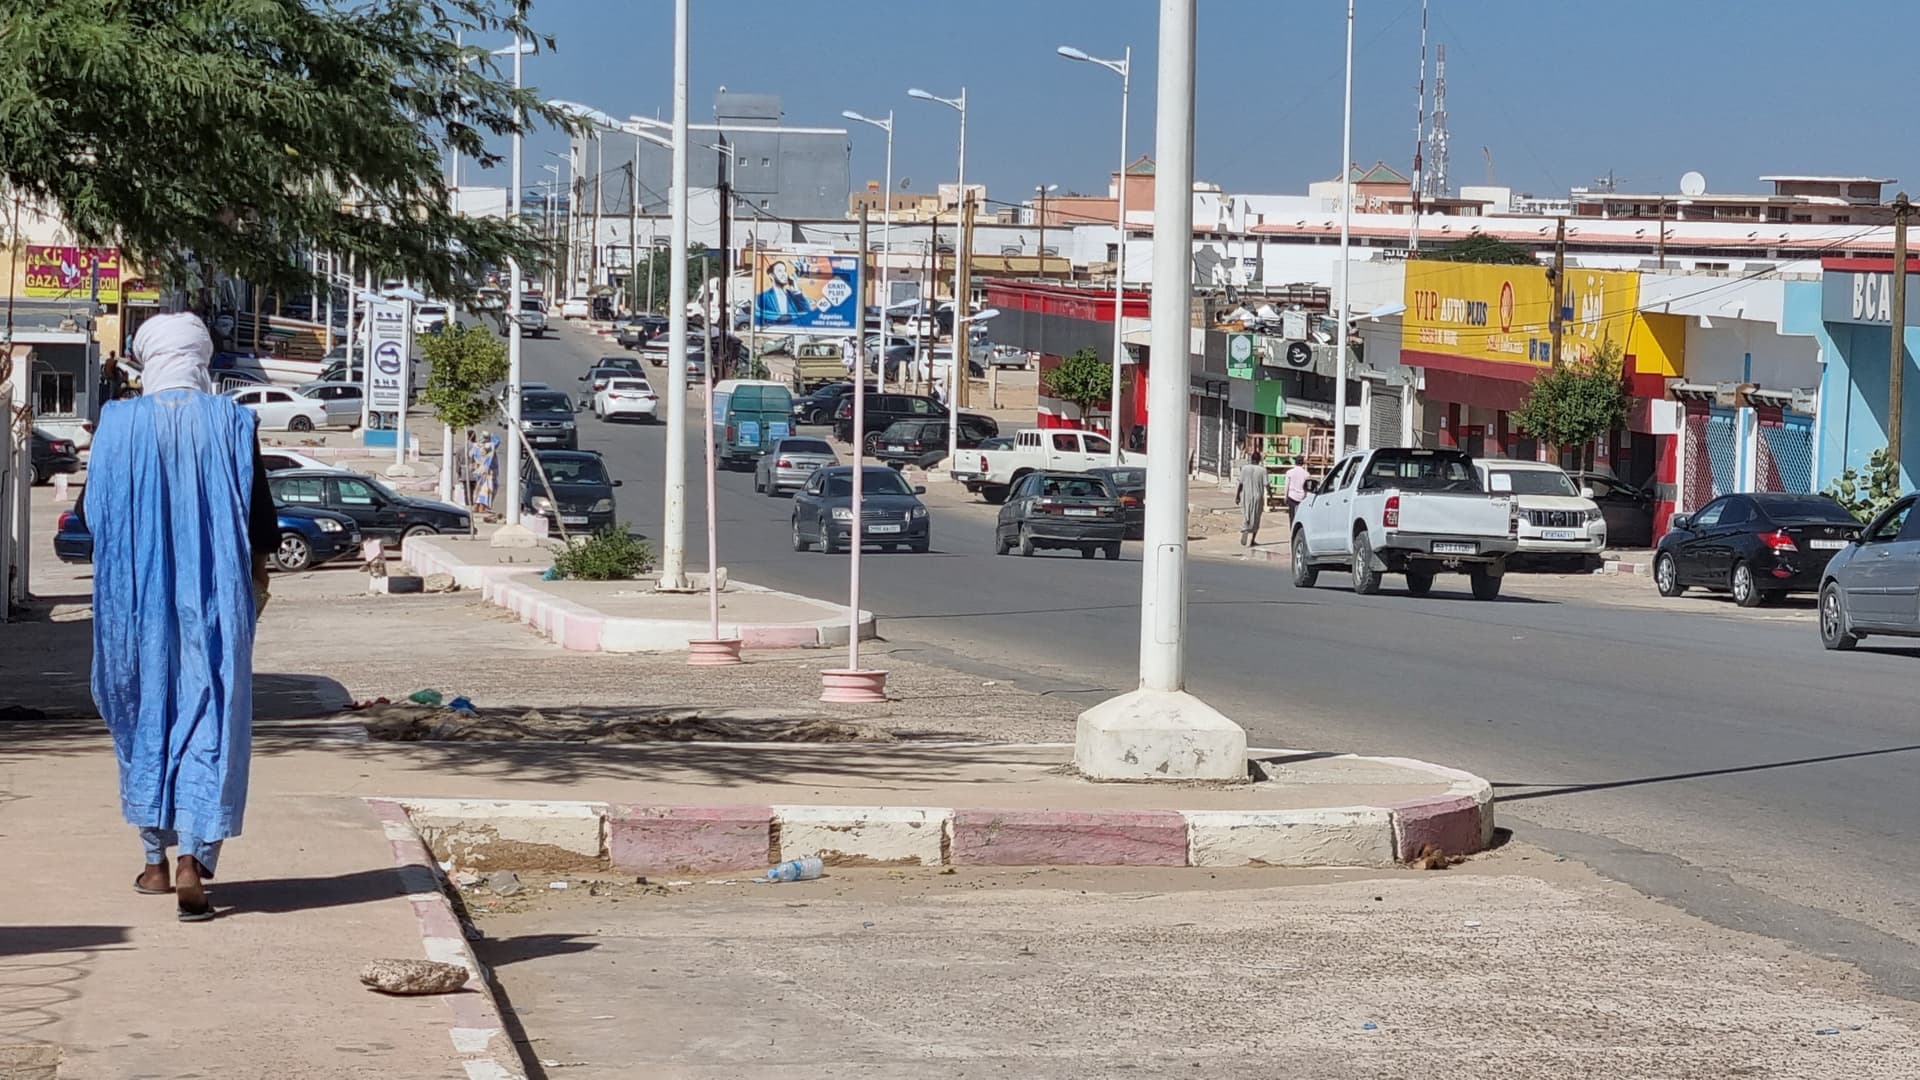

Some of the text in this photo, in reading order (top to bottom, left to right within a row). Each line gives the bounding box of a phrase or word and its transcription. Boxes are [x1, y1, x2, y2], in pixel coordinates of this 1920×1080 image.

[26, 275, 118, 290] GAZA TECOM
[1853, 272, 1891, 321] BCA
[1415, 290, 1488, 327] VIP AUTO PLUS
